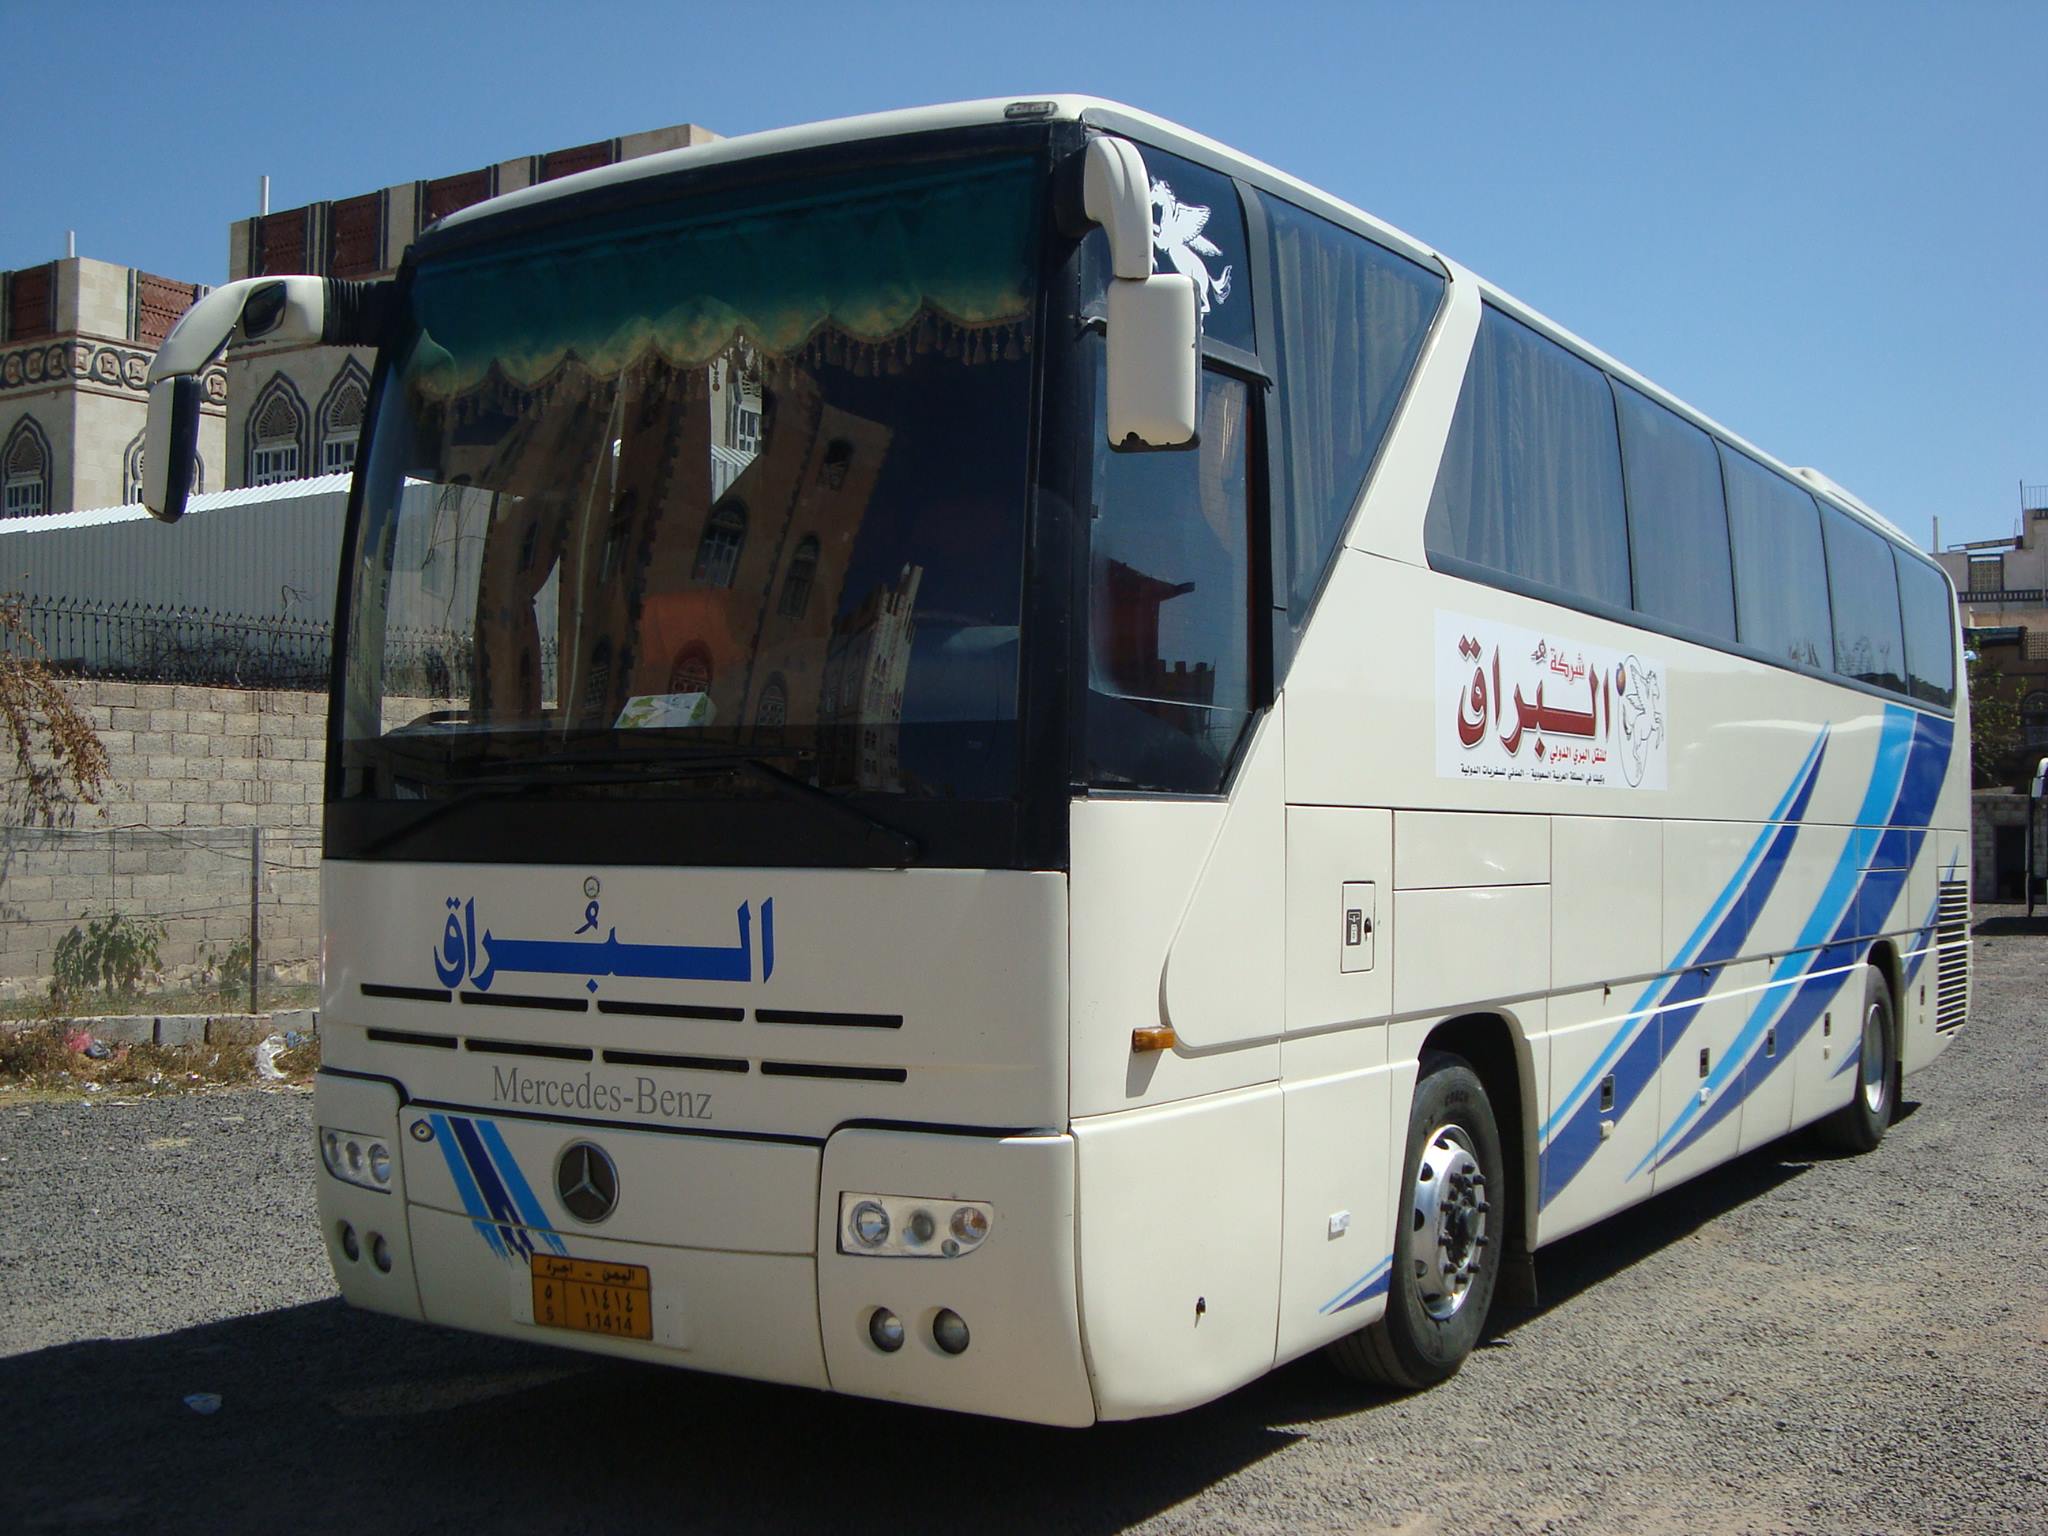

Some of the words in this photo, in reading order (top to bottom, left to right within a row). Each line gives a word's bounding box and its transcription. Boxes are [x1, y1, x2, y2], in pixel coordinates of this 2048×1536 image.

[1550, 648, 1585, 682] شركة
[1550, 744, 1572, 765] الدولي
[492, 1065, 713, 1120] Mercedes-Benz
[602, 1267, 636, 1285] اليمن
[585, 1311, 633, 1332] 11414
